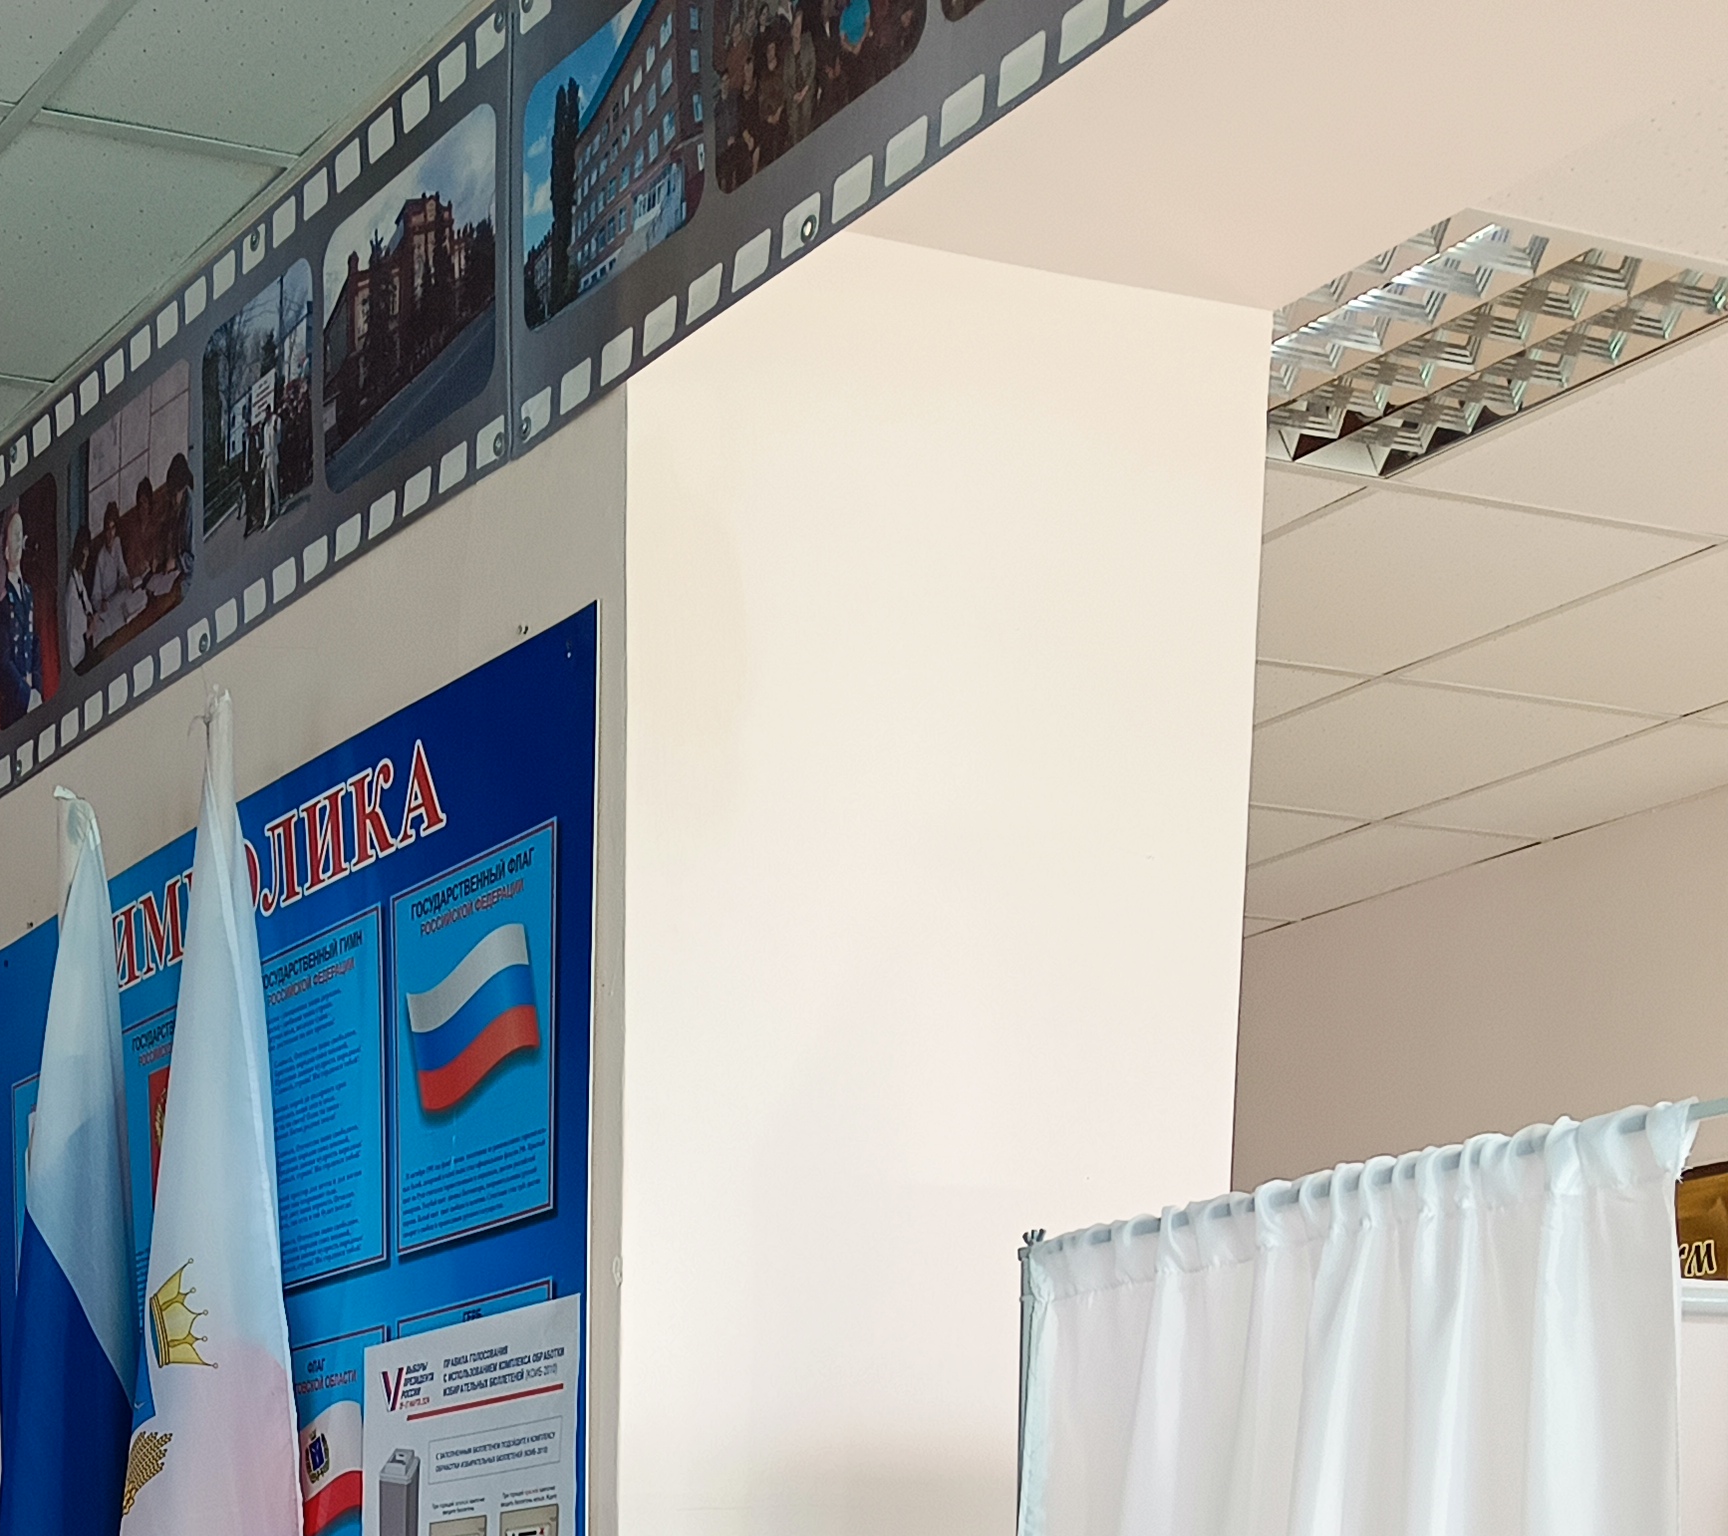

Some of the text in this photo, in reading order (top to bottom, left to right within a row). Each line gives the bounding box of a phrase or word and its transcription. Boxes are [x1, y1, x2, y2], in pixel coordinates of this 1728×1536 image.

[112, 739, 447, 992] ИМЛИКА
[411, 847, 534, 921] ГОСУДАРСТВЕННЫЙ ФЛАГ
[263, 930, 363, 989] ОСУДАРСТВЕННЫЙ ГИМН
